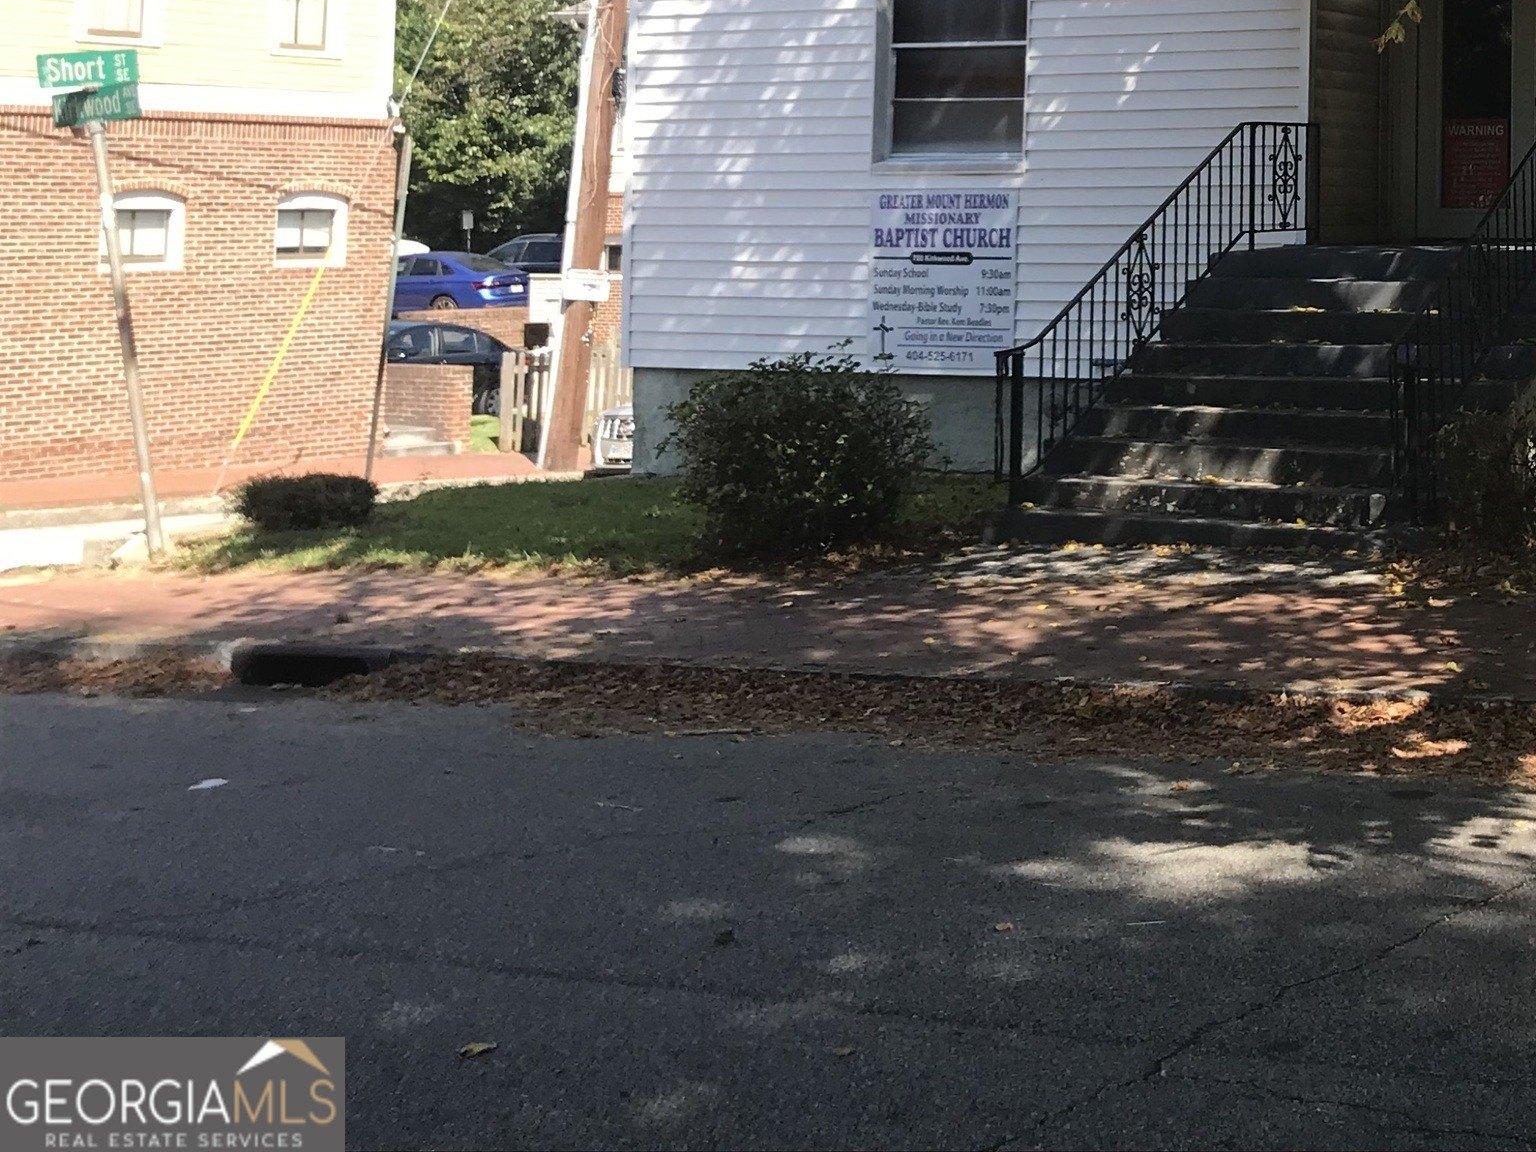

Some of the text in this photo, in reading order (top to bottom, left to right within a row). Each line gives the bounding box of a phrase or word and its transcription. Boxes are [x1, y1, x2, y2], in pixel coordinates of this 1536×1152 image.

[46, 53, 126, 83] Short ST
[116, 67, 130, 82] SE
[1448, 124, 1504, 136] WARNING
[879, 193, 1009, 209] GREATER MOUNT HERMON
[904, 212, 982, 225] MISSIONARY
[874, 228, 1012, 248] BAPTIST CHURCH
[873, 267, 1011, 279] Sunday School 9:30am
[873, 284, 1011, 298] Sunday Morning Worship 11:00am
[939, 302, 962, 315] Study
[904, 331, 928, 344] Going
[945, 332, 964, 342] New
[965, 332, 1003, 342] Direction
